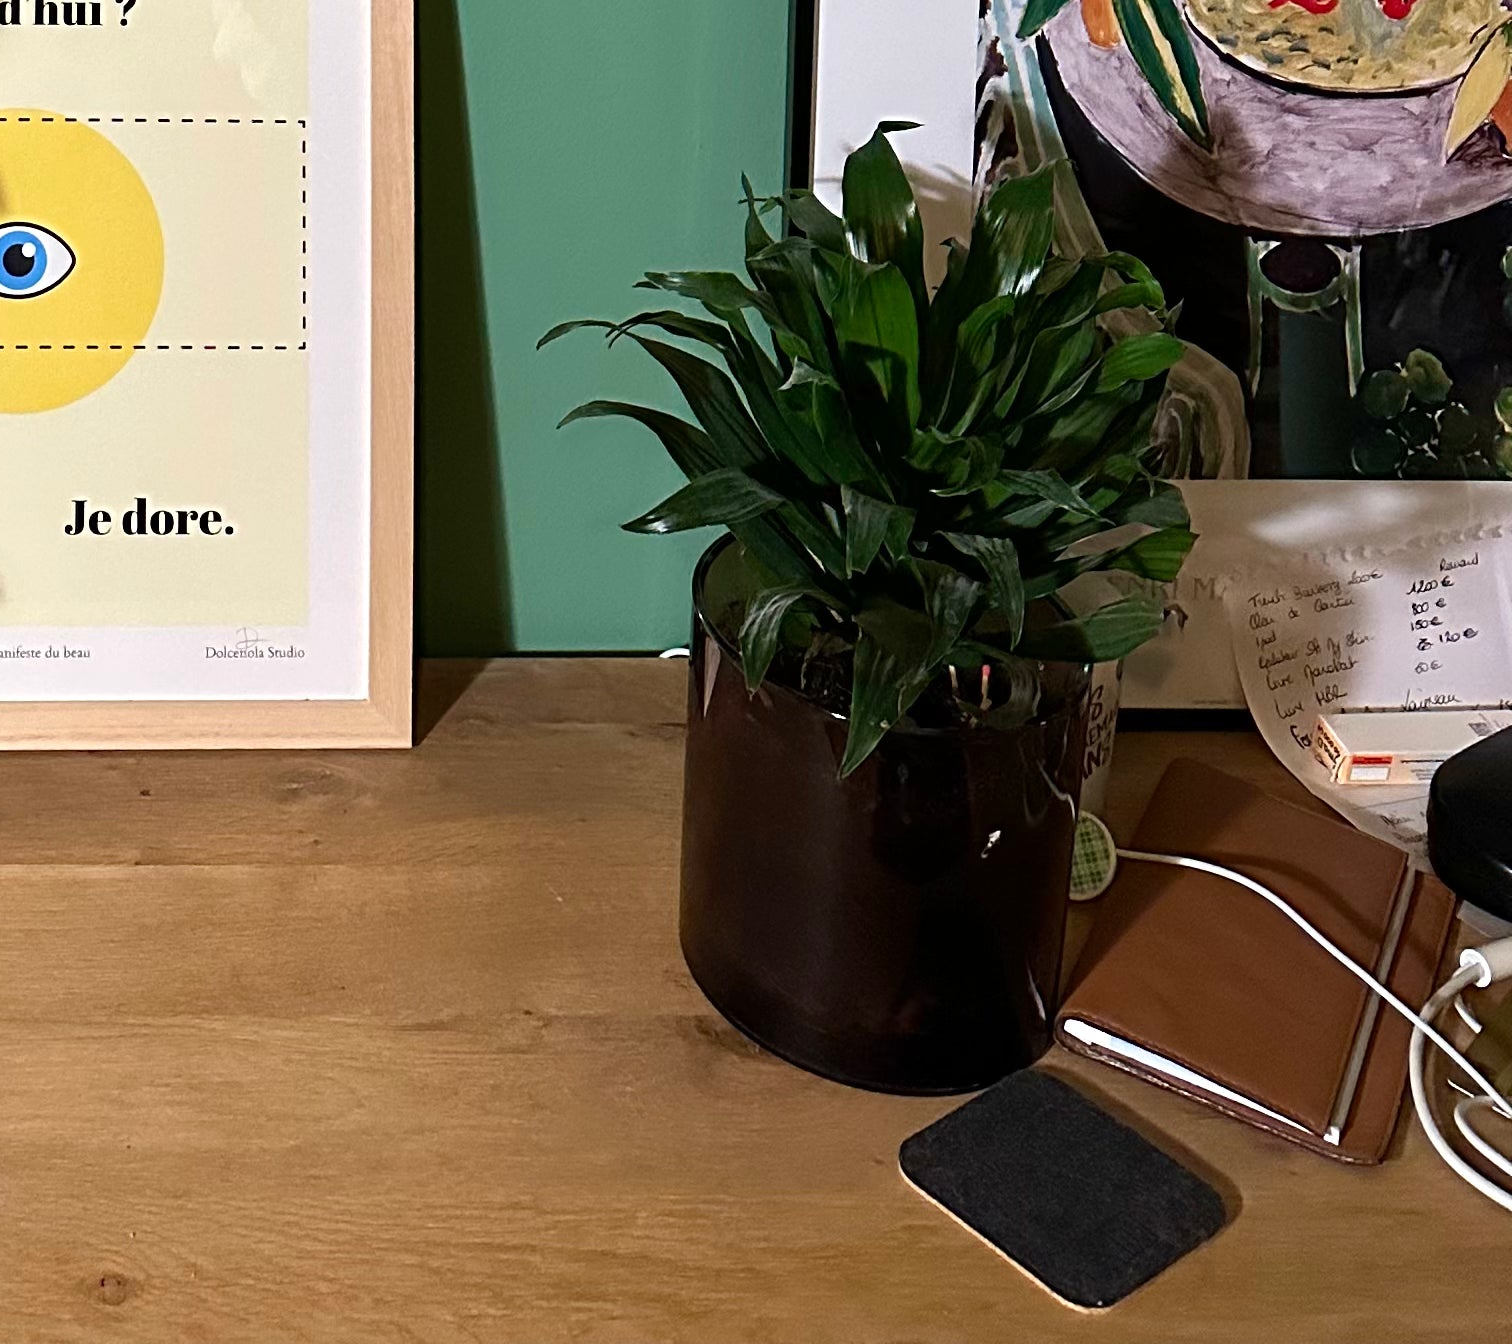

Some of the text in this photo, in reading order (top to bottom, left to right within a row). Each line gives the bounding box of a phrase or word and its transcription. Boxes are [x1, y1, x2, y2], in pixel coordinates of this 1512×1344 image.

[64, 497, 234, 535] Je dore.
[44, 646, 61, 659] du
[63, 646, 91, 659] beau
[205, 646, 306, 659] Dolcenola Studio
